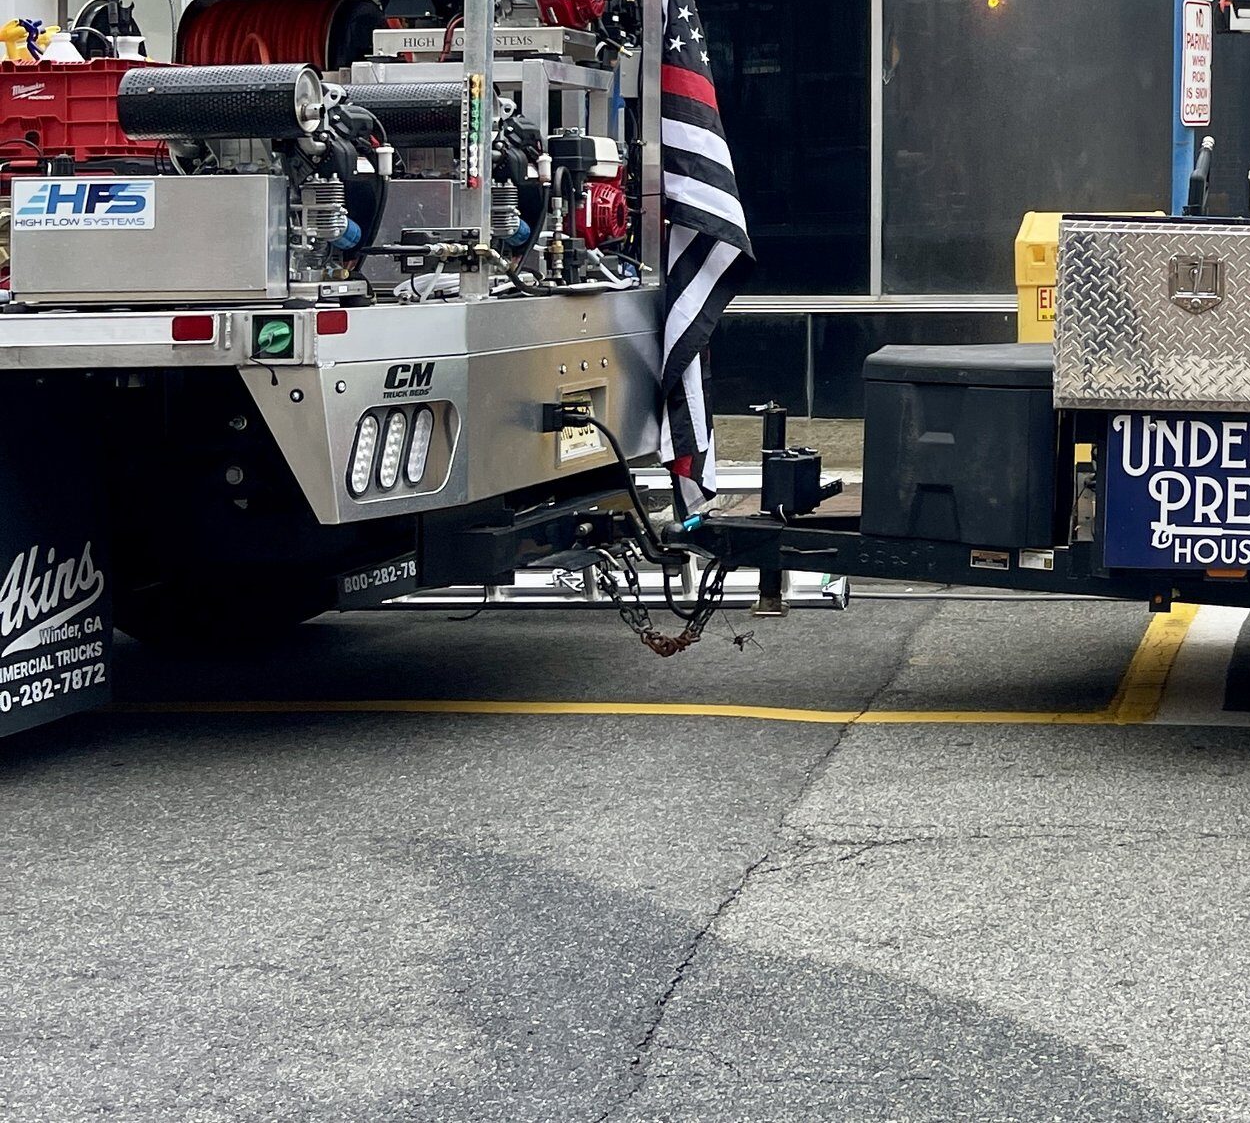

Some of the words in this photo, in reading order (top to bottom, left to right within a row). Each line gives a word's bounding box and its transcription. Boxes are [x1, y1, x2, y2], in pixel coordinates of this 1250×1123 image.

[1196, 10, 1204, 28] NO
[403, 36, 435, 48] HIGH
[495, 35, 534, 46] STEMS
[1186, 33, 1210, 51] PARKING
[1186, 87, 1193, 99] IS
[1185, 104, 1209, 116] COVERED
[46, 184, 147, 214] HFS
[15, 218, 42, 227] HIGH
[45, 218, 80, 226] FLOW
[83, 217, 145, 226] SYSTEMS
[384, 362, 435, 389] CM
[383, 390, 408, 399] TRUCK
[344, 560, 417, 593] 800-282-78
[0, 541, 103, 637] Akins
[39, 623, 82, 645] Winder,
[84, 616, 103, 634] GA
[56, 641, 103, 668] TRUCKS
